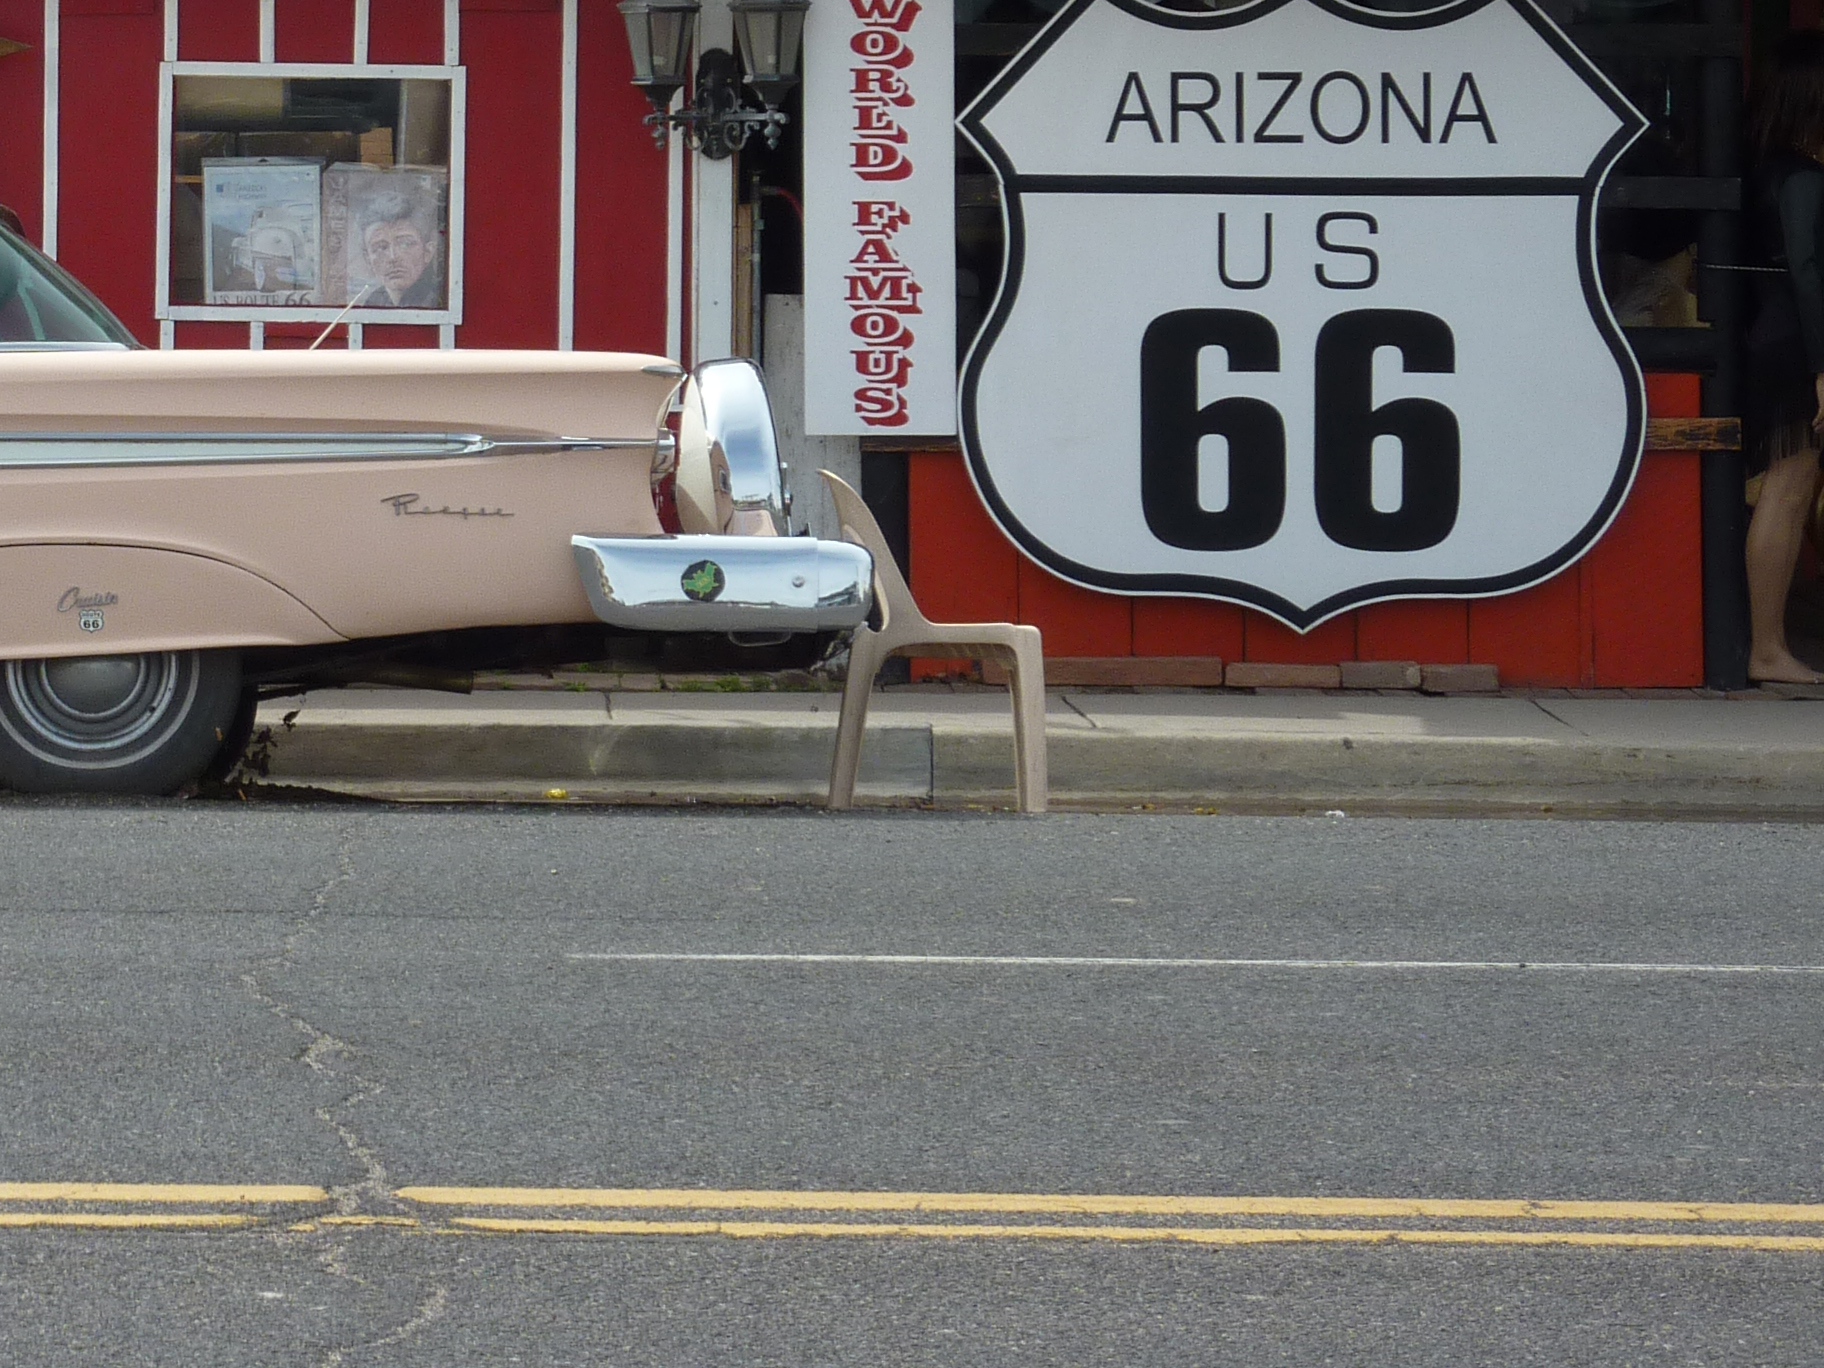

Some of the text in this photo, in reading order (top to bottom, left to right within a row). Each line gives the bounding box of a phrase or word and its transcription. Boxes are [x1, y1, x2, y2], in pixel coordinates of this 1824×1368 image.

[1105, 70, 1498, 145] ARIZONA
[843, 199, 923, 428] FAMOUS
[1140, 307, 1461, 552] 66
[83, 619, 100, 629] 66
